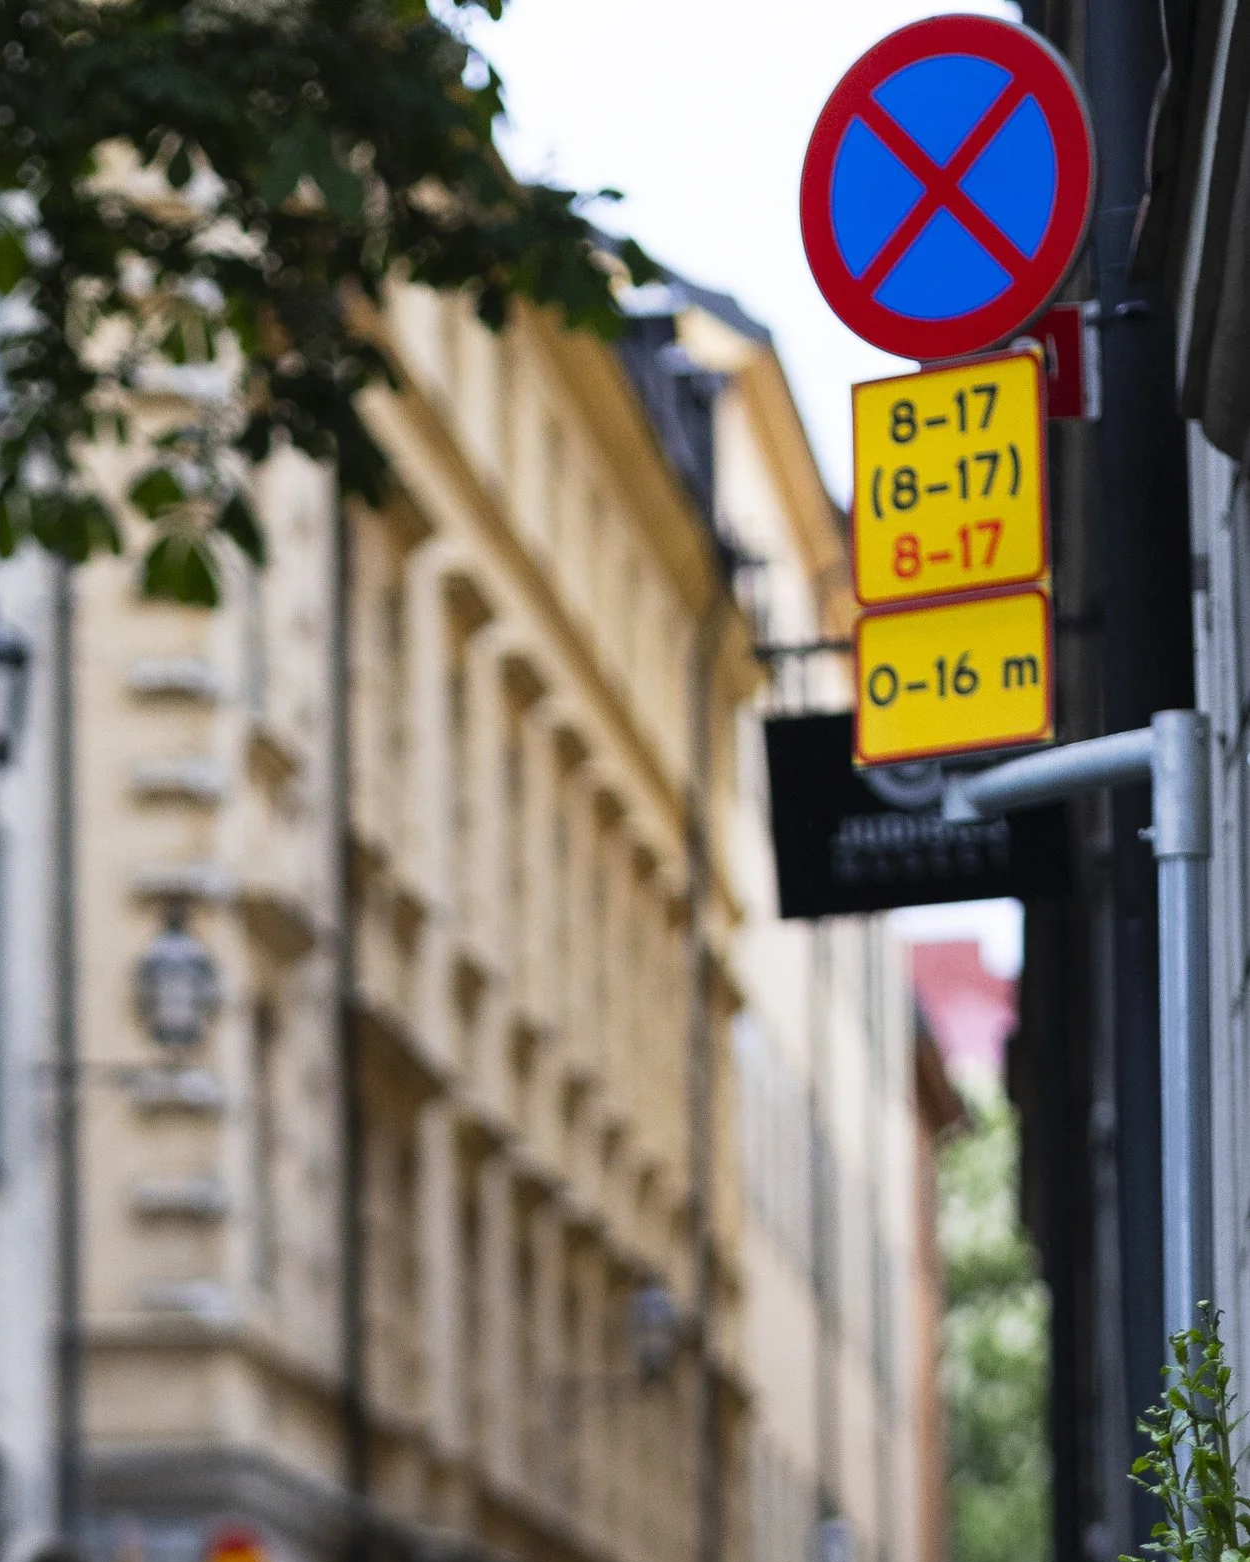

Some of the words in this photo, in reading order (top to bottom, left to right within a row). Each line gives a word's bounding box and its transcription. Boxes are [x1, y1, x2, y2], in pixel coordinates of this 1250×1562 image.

[889, 383, 999, 445] 8-17
[871, 442, 1021, 520] (8-17)
[892, 518, 1003, 579] 8-17
[867, 650, 979, 708] 0-16
[1002, 654, 1040, 689] m
